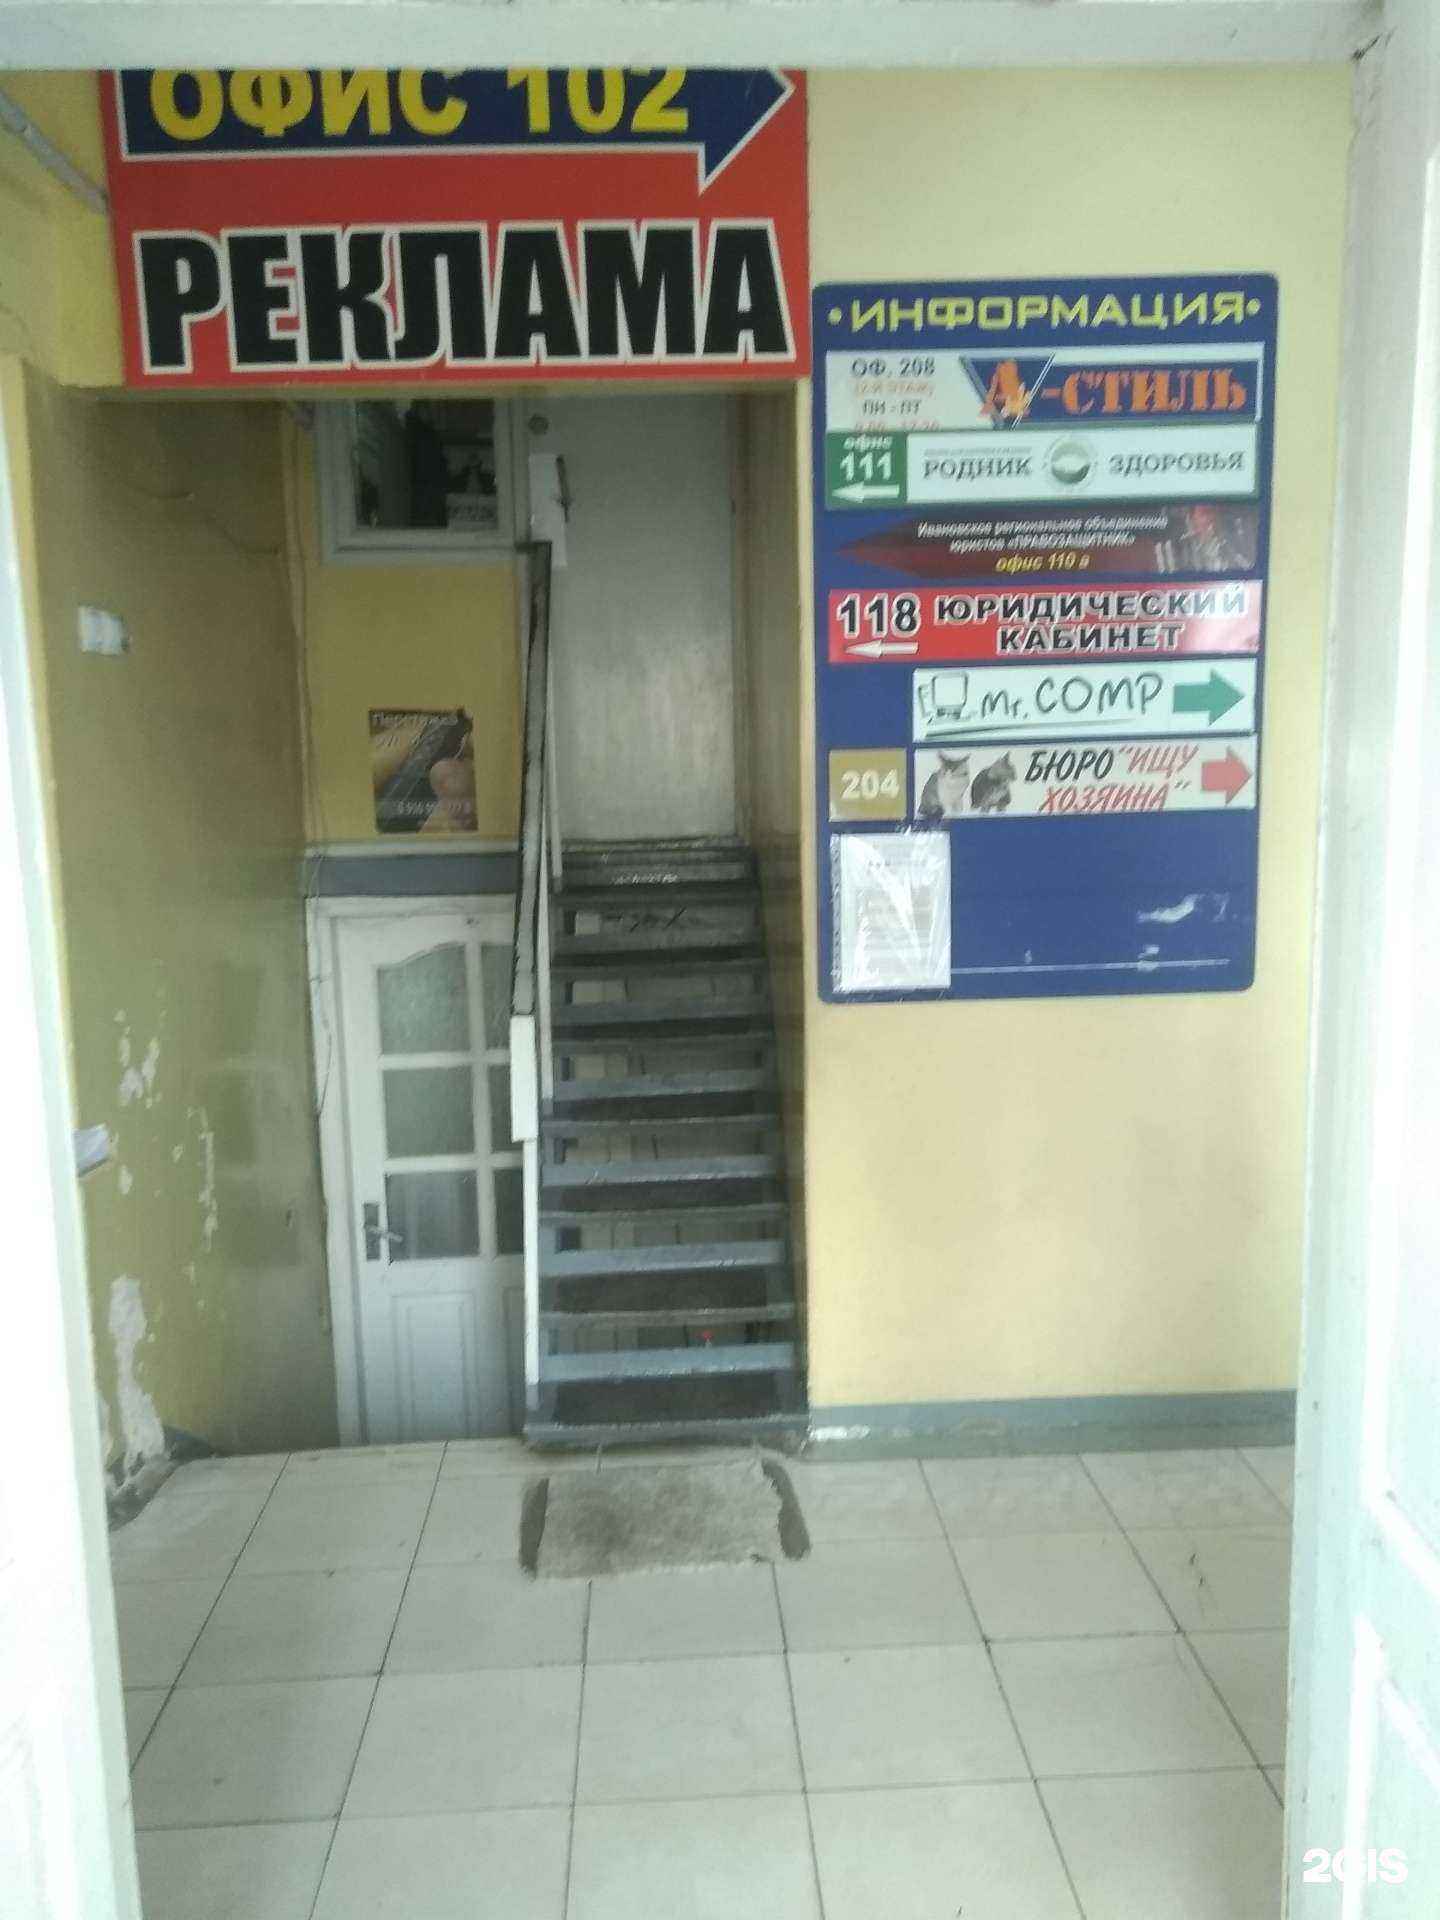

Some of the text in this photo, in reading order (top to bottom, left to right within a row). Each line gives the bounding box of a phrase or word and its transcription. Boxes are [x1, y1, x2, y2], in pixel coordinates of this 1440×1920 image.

[150, 67, 690, 141] ОФИС 102
[133, 219, 797, 374] РЕКЛАМА
[851, 291, 1246, 332] ИНФОРМАЦИЯ
[899, 356, 936, 377] 208
[840, 452, 892, 481] 111
[923, 452, 1246, 481] РОДНИК ЗДОРОВЬЯ
[995, 556, 1043, 575] офис
[1048, 551, 1076, 571] 110
[836, 592, 921, 639] 118
[934, 579, 1247, 625] ЮРИДИЧЕСКИЙ
[997, 622, 1186, 655] КАБИНЕТ
[1035, 671, 1163, 715] COMP
[1024, 747, 1115, 782] БЮРО
[841, 769, 900, 800] 204
